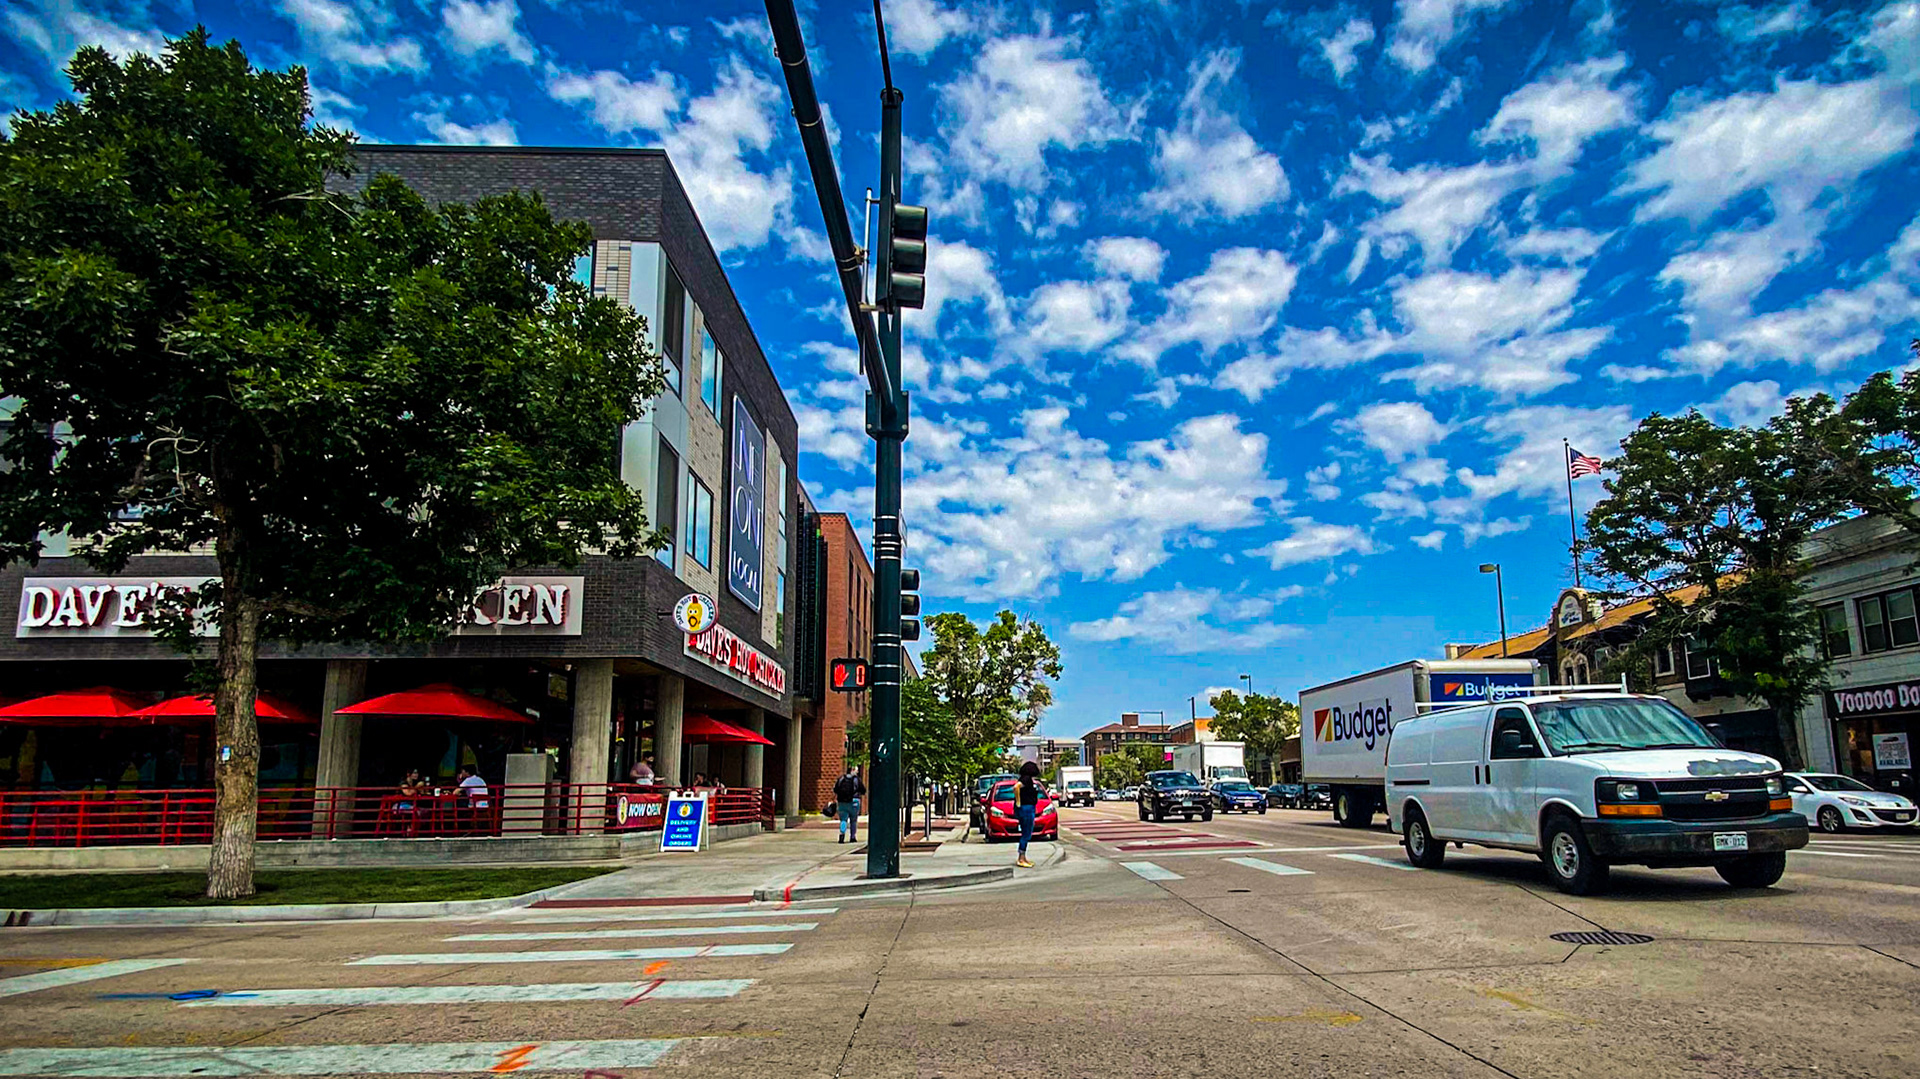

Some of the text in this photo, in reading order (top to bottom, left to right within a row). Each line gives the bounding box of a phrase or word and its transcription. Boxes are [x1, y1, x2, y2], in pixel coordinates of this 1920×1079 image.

[732, 550, 759, 595] LOCAL
[21, 582, 190, 627] DAVE'
[735, 643, 753, 676] HOT
[755, 654, 786, 694] CHICKEN
[856, 665, 866, 686] 0
[1466, 682, 1521, 701] Budget
[1834, 689, 1895, 714] VOODOO
[1332, 698, 1394, 751] Budget
[628, 803, 662, 817] NOW OPEN
